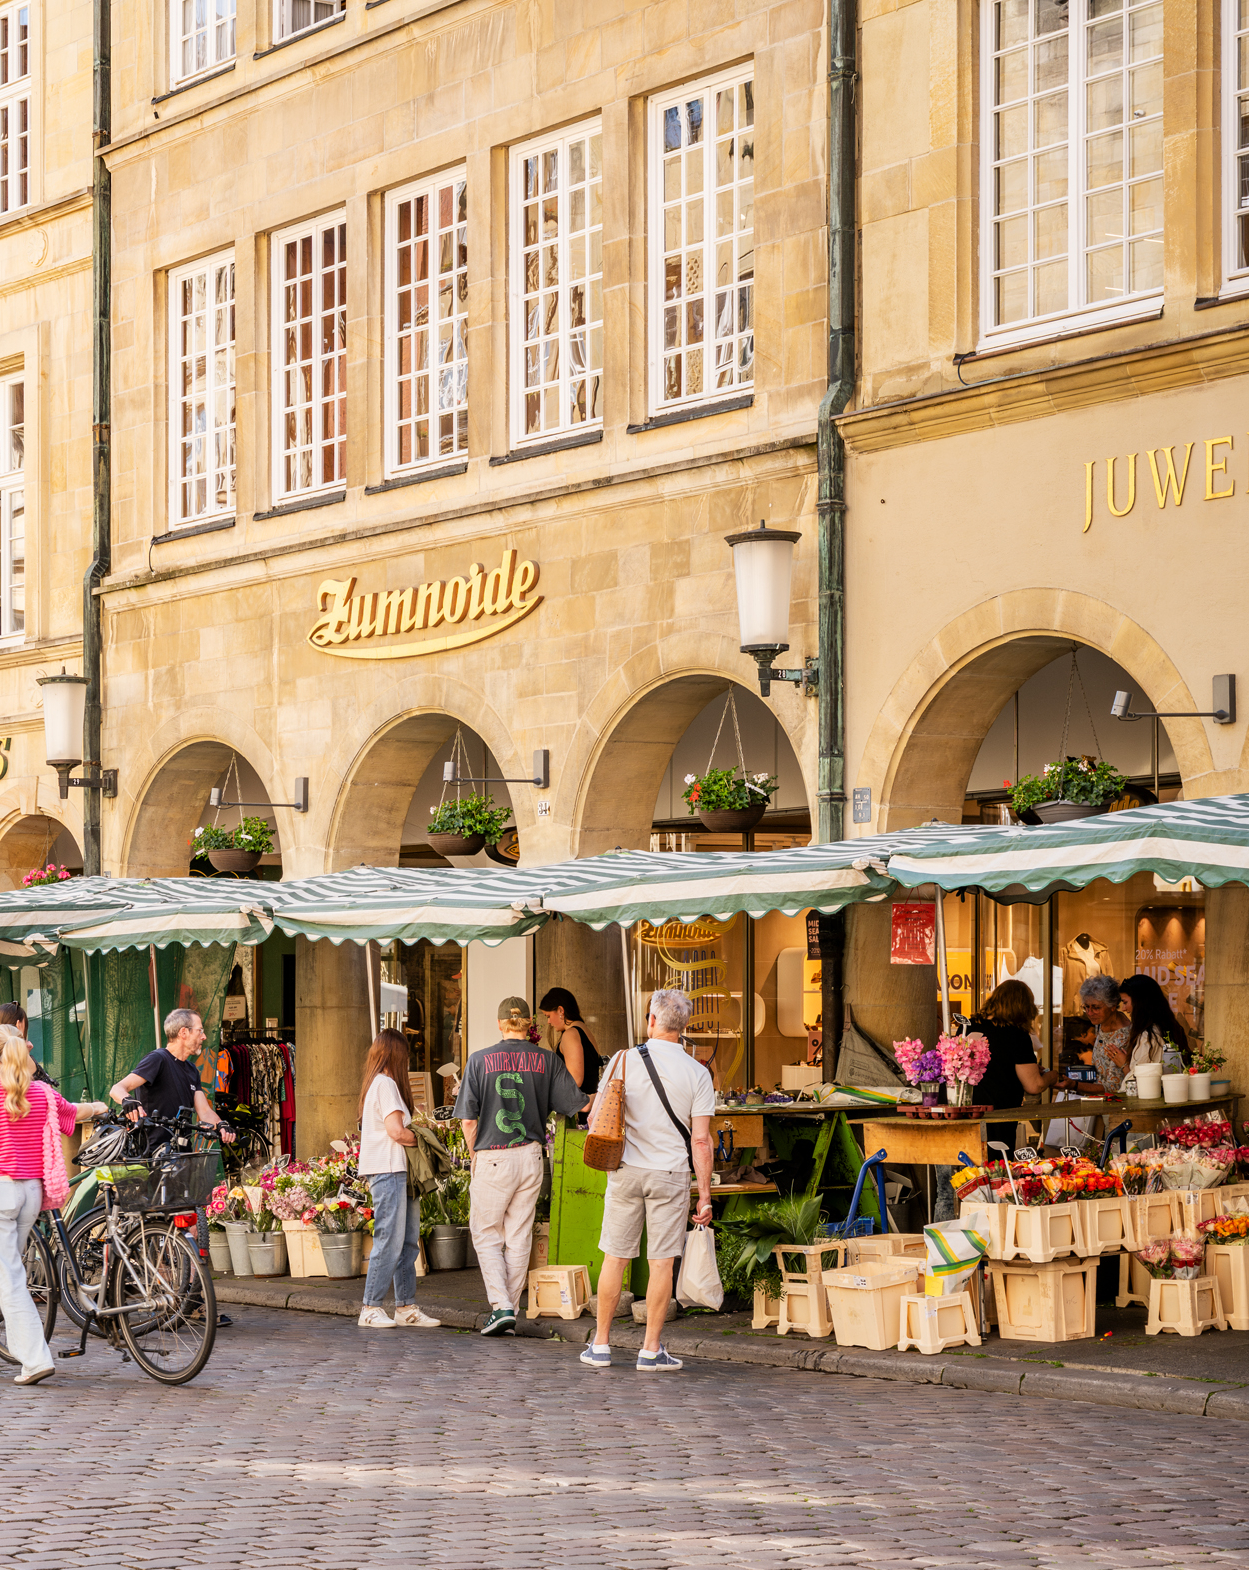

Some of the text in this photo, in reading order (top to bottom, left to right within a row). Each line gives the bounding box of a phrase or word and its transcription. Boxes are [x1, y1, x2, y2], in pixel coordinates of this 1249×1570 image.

[1082, 435, 1236, 534] JUWE
[778, 669, 786, 678] 28
[1135, 949, 1153, 960] 20%
[483, 1051, 545, 1075] NIRVANA
